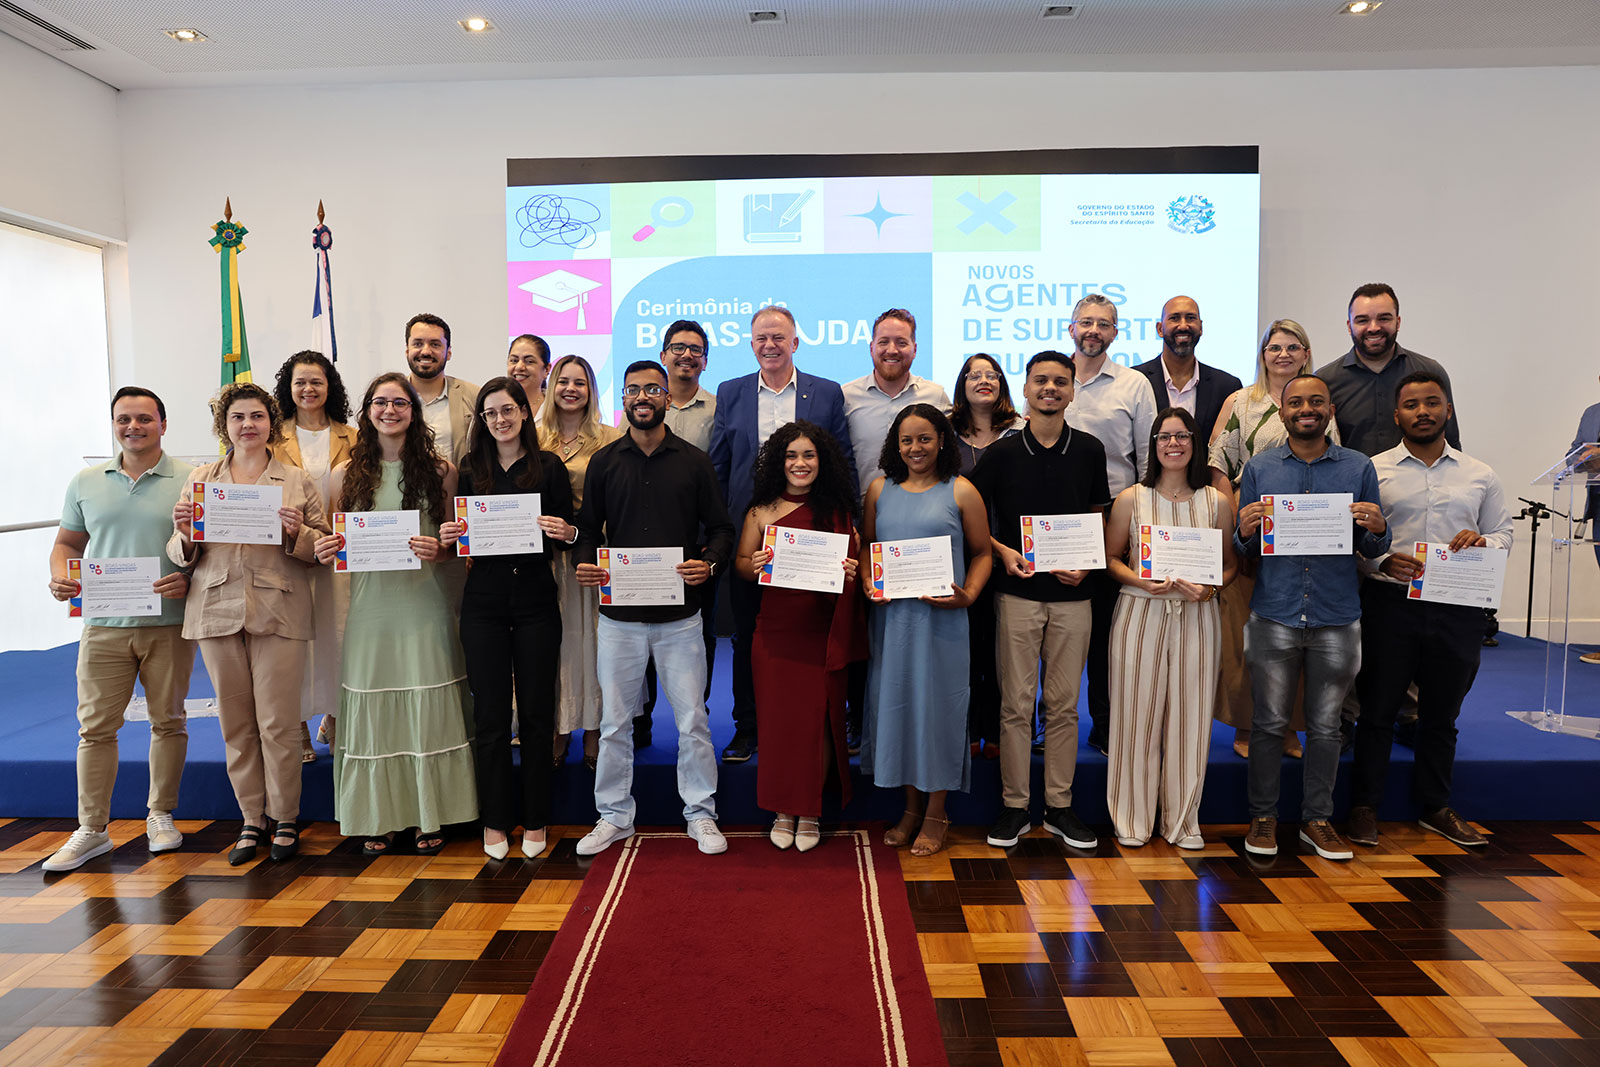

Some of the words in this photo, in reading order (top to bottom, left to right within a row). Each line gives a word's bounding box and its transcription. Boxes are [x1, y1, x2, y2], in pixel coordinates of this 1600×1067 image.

[968, 265, 1034, 280] NOVOS
[636, 298, 753, 316] Cerimônia
[963, 318, 1003, 341] DE
[1013, 318, 1164, 341] SUPRT
